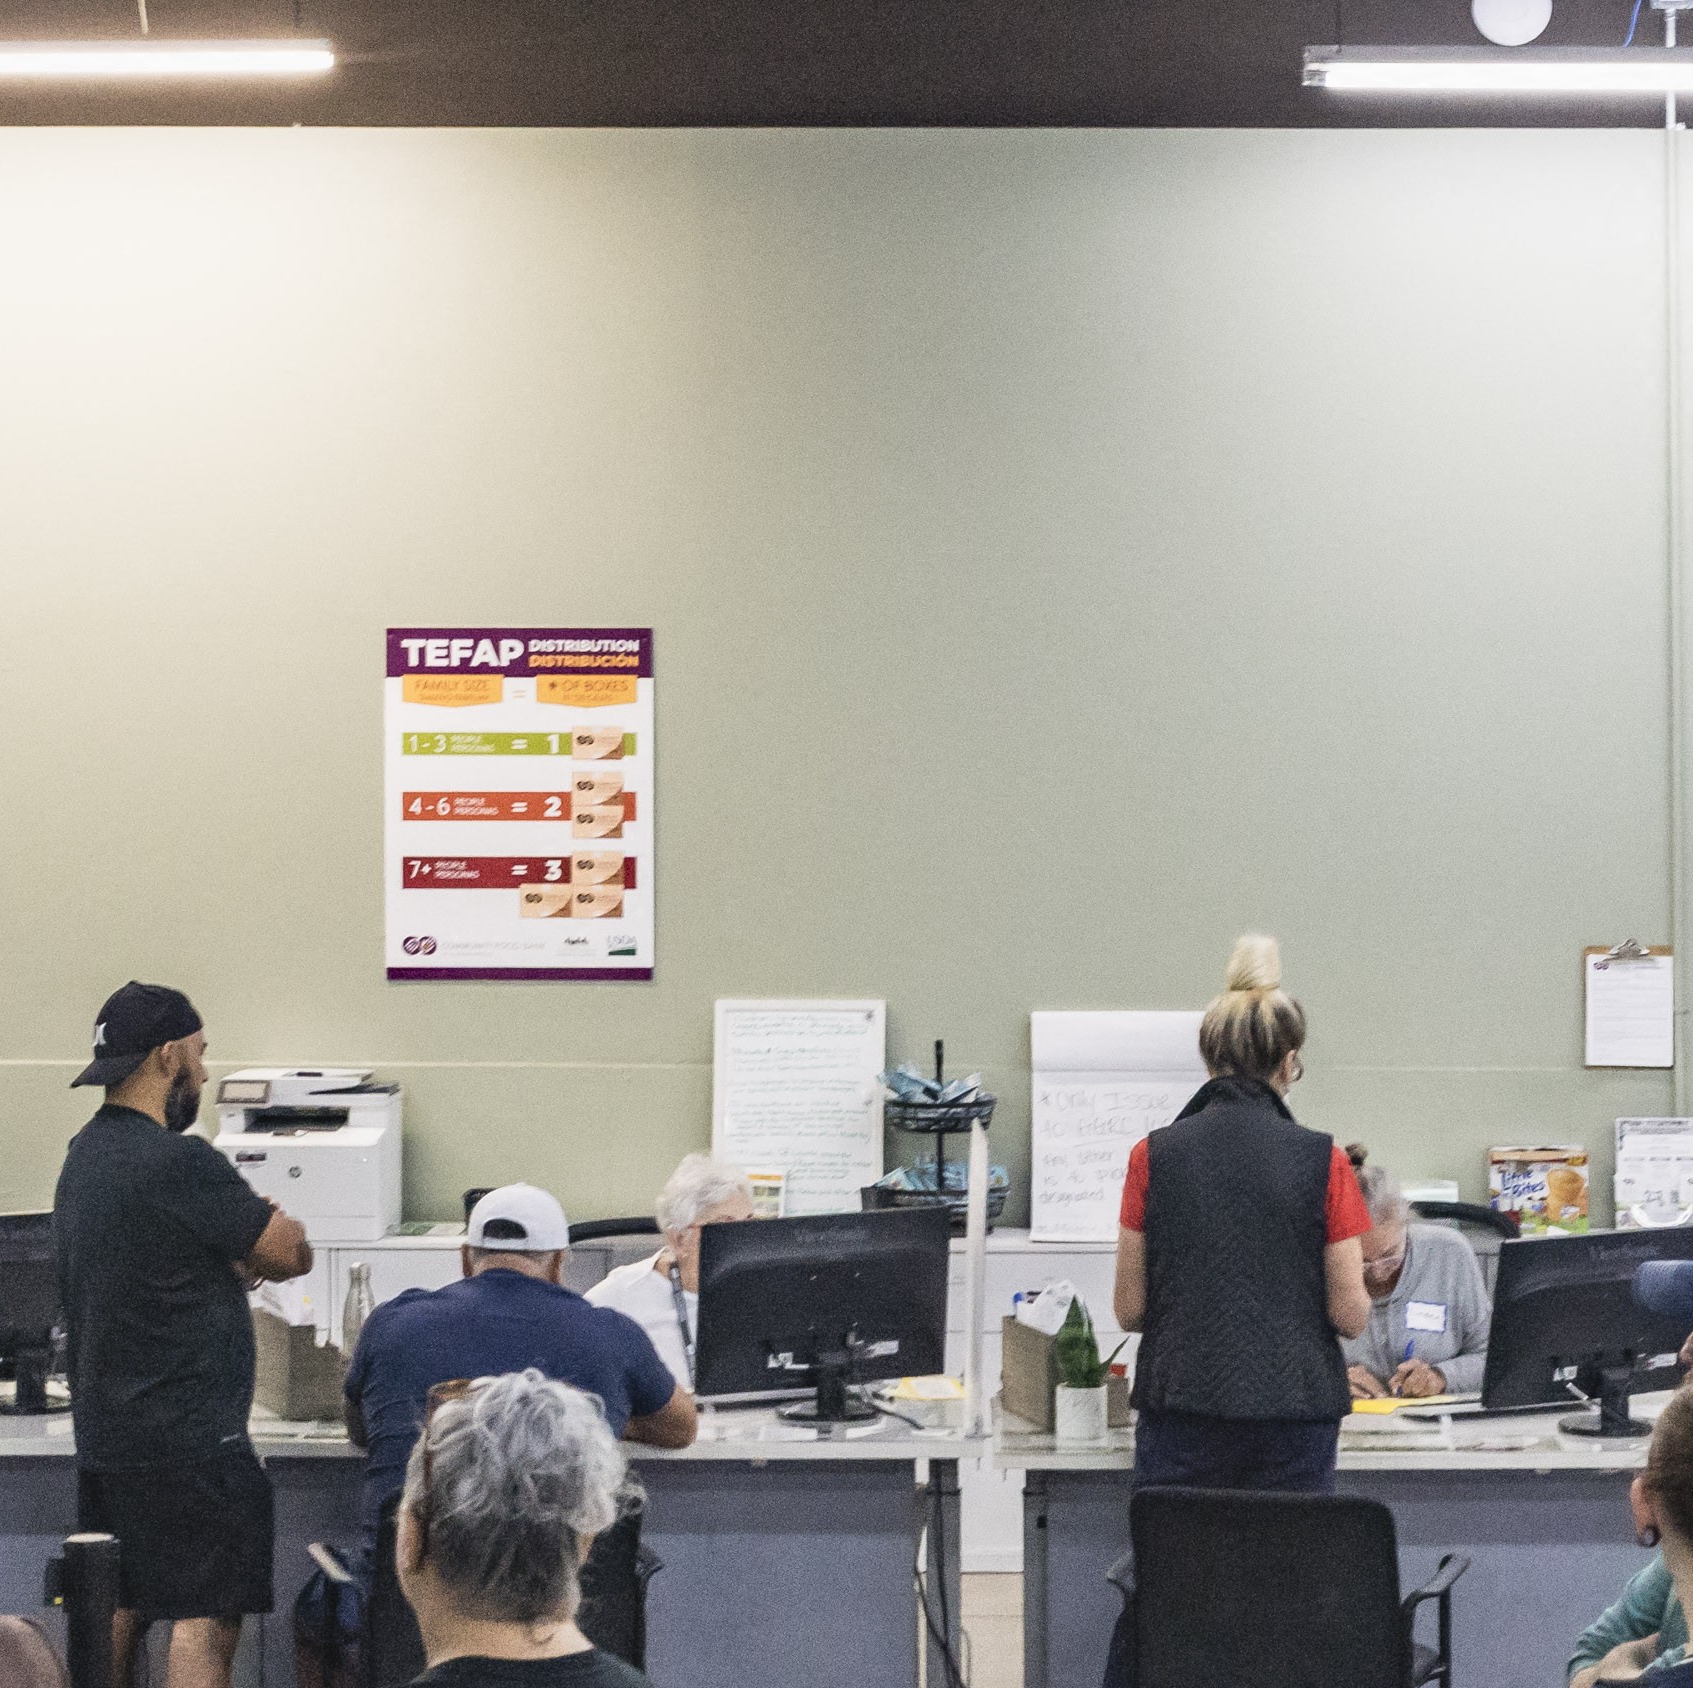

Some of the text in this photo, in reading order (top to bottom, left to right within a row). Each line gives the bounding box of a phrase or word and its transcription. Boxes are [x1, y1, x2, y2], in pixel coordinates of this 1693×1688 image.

[401, 638, 640, 668] TEFAP DISTRIBUTION
[528, 653, 640, 668] DISTRIBUCIÓN
[415, 679, 459, 692] FAMILY
[463, 679, 491, 692] SIZE
[562, 679, 580, 692] OF
[584, 679, 629, 692] BOXES
[547, 734, 560, 754] 1
[544, 797, 563, 817] 2
[544, 860, 563, 881] 3
